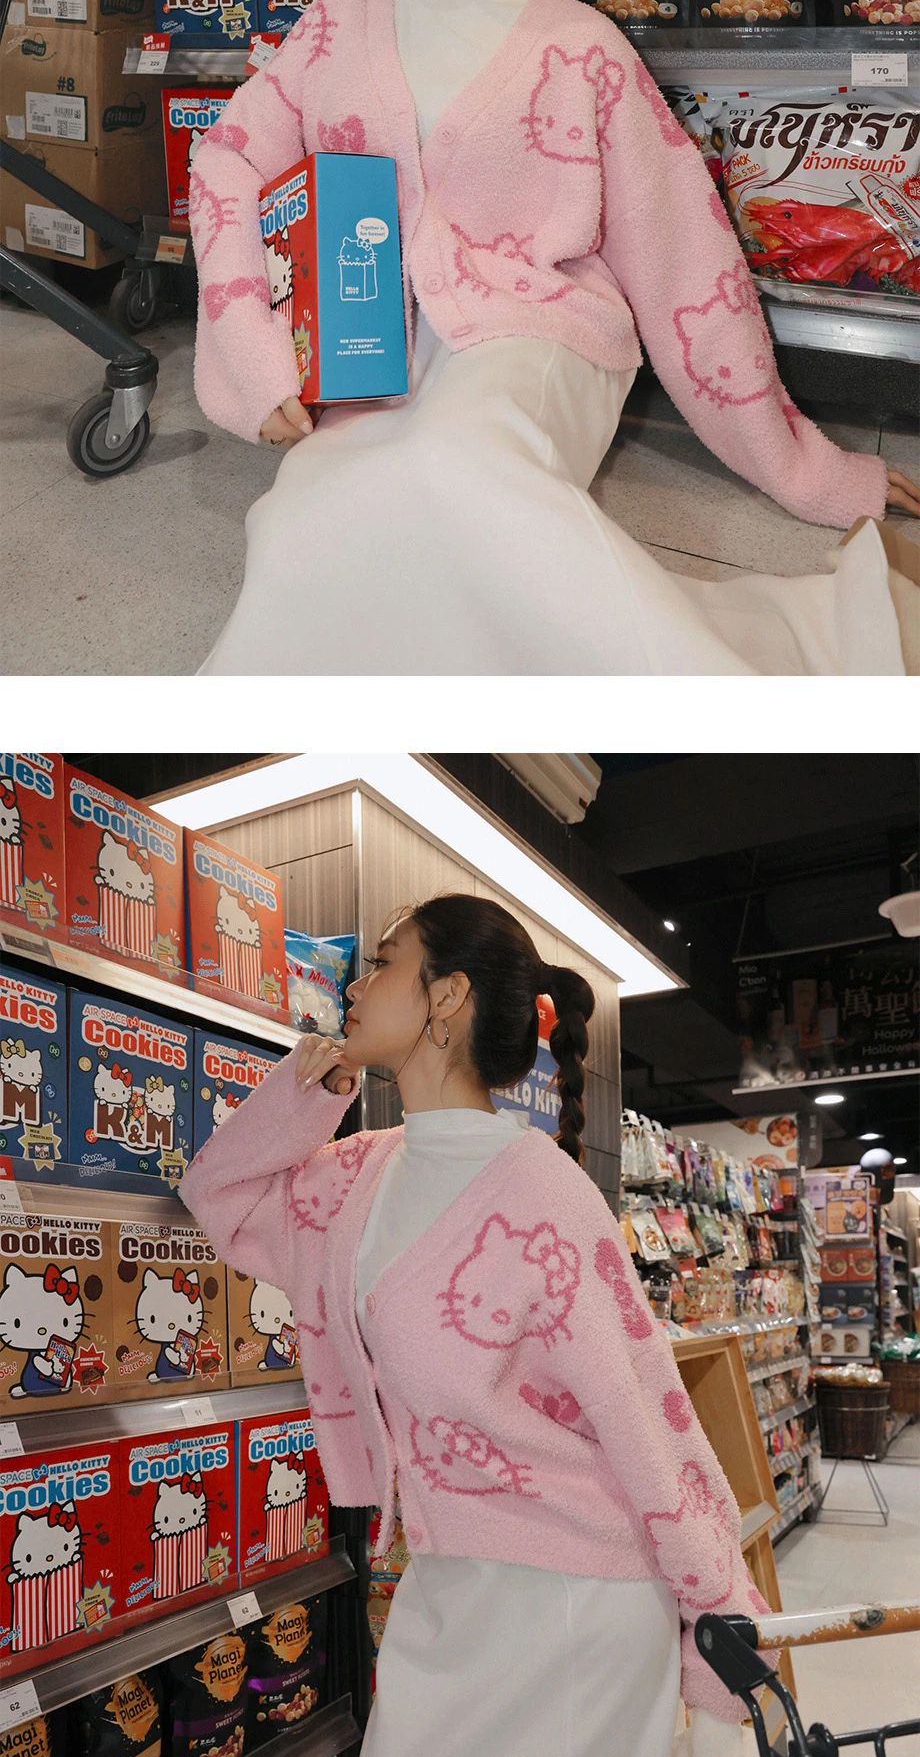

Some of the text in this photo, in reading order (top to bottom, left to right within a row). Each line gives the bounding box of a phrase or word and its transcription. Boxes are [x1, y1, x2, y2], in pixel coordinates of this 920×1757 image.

[871, 67, 889, 75] 170
[72, 793, 176, 864] Cookies
[195, 853, 276, 910] Cookies
[85, 1019, 186, 1068] Cookies
[140, 1023, 187, 1044] HELLO KITTY
[43, 1219, 100, 1232] HELLO KITTY
[121, 1237, 216, 1261] Cookies
[181, 1434, 228, 1450] HELLO KITTY
[131, 1449, 227, 1484] Cookies
[210, 1646, 242, 1668] Magi
[10, 1701, 20, 1710] 62
[119, 1685, 144, 1707] Magi
